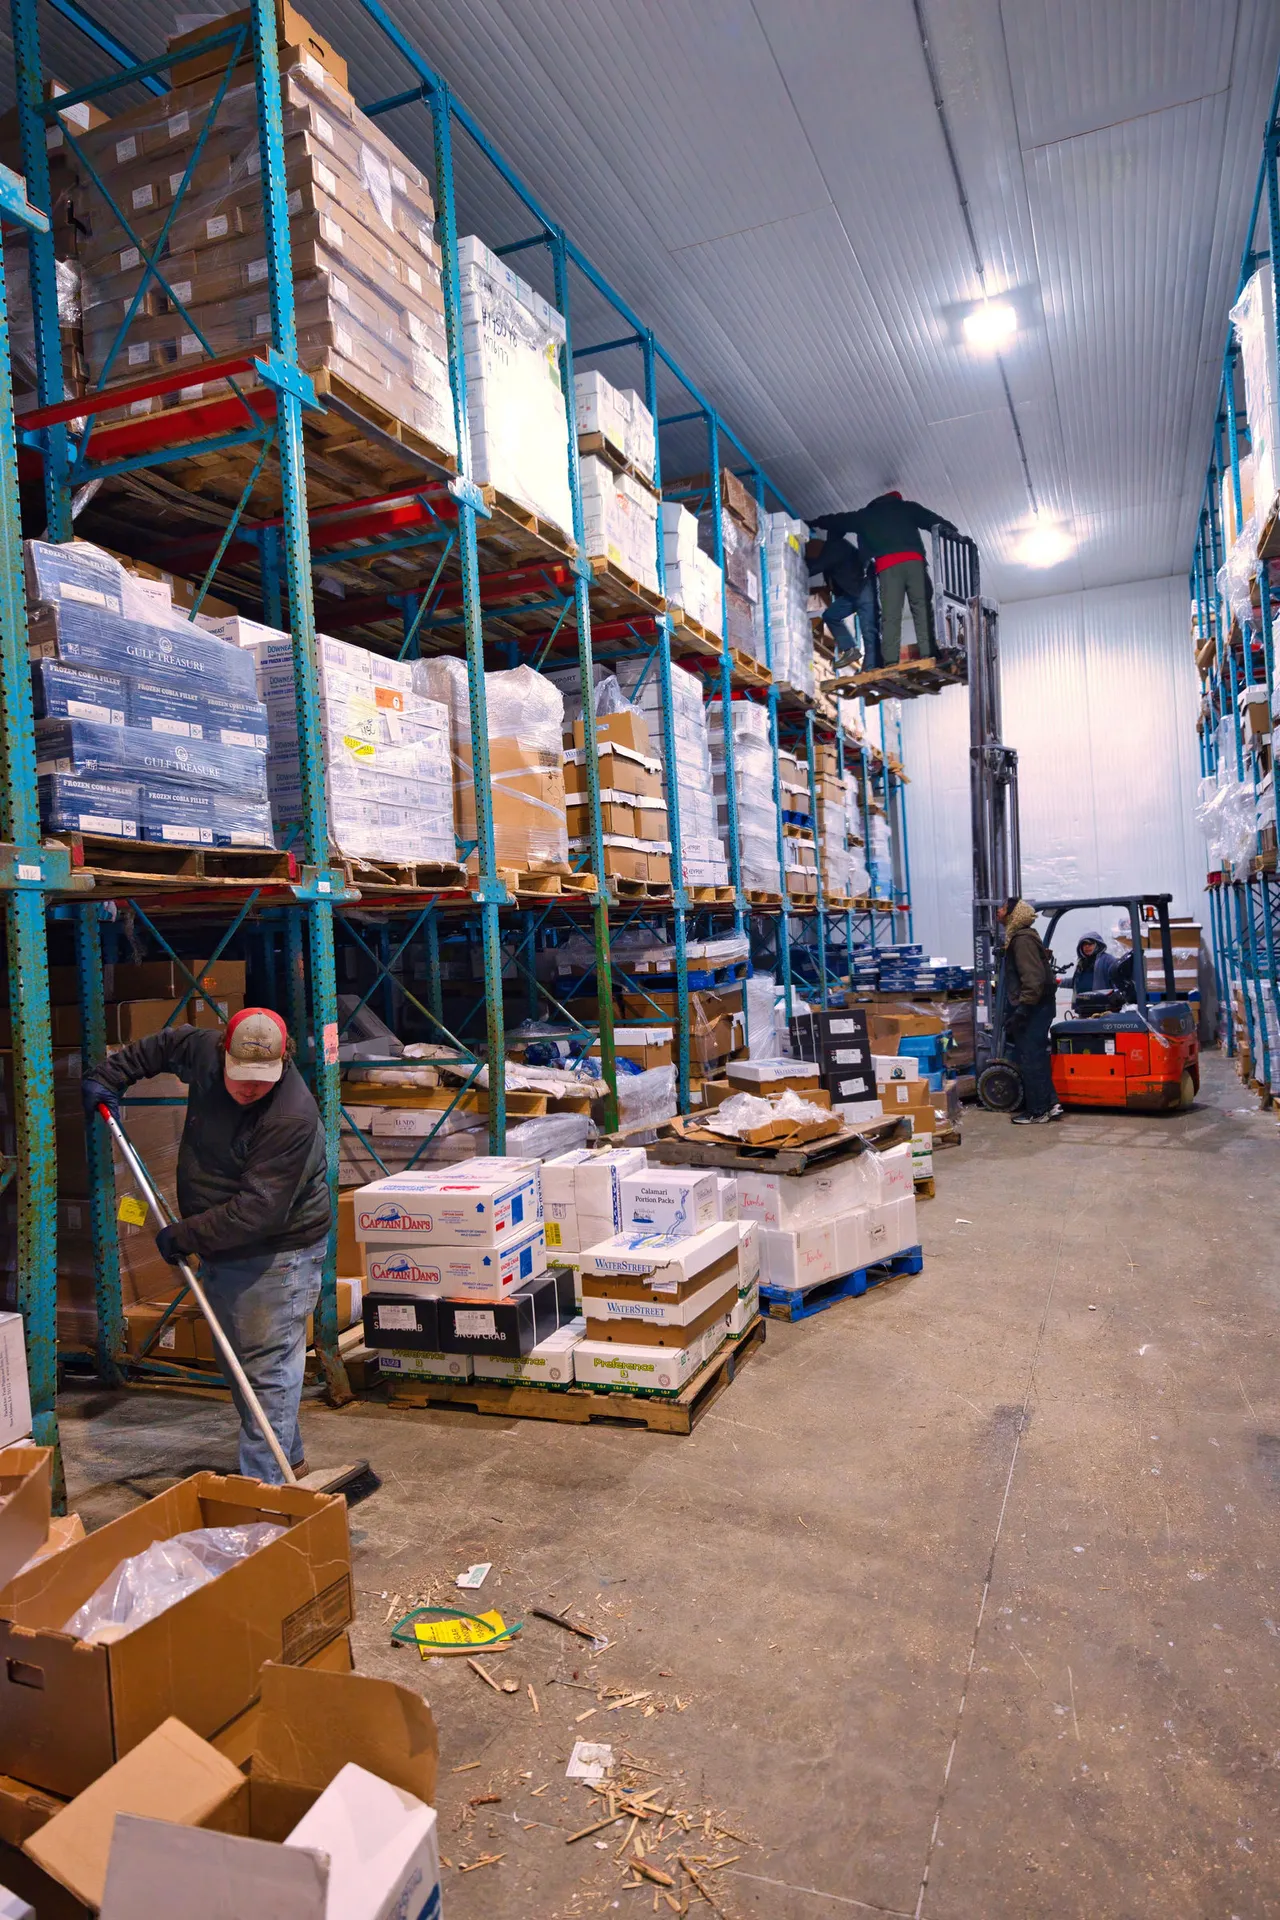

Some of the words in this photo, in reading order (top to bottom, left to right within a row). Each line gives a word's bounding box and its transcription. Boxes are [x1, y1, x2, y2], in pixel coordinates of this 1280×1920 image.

[126, 645, 155, 660] GULF
[156, 651, 205, 672] TREASURE
[49, 664, 77, 676] FROZEN
[78, 671, 98, 681] COBIA
[99, 675, 120, 686] FILLET
[138, 684, 160, 693] FROZEN
[162, 688, 179, 697] COBIA
[208, 699, 229, 708] FROZEN
[144, 756, 171, 769] GULF
[173, 760, 221, 778] TREASURE
[63, 779, 91, 789] FROZEN
[91, 784, 110, 793] COBIA
[148, 792, 172, 800] FROZEN
[172, 795, 189, 803] COBIA
[190, 797, 209, 805] FILLET
[976, 935, 984, 973] TOYOTA
[641, 1187, 668, 1195] Calamari
[360, 1214, 401, 1230] CAPTAIN
[401, 1215, 431, 1230] DAN'S
[372, 1264, 410, 1280] CAPTAIN
[410, 1266, 439, 1282] DAN'S
[594, 1357, 655, 1372] Preference
